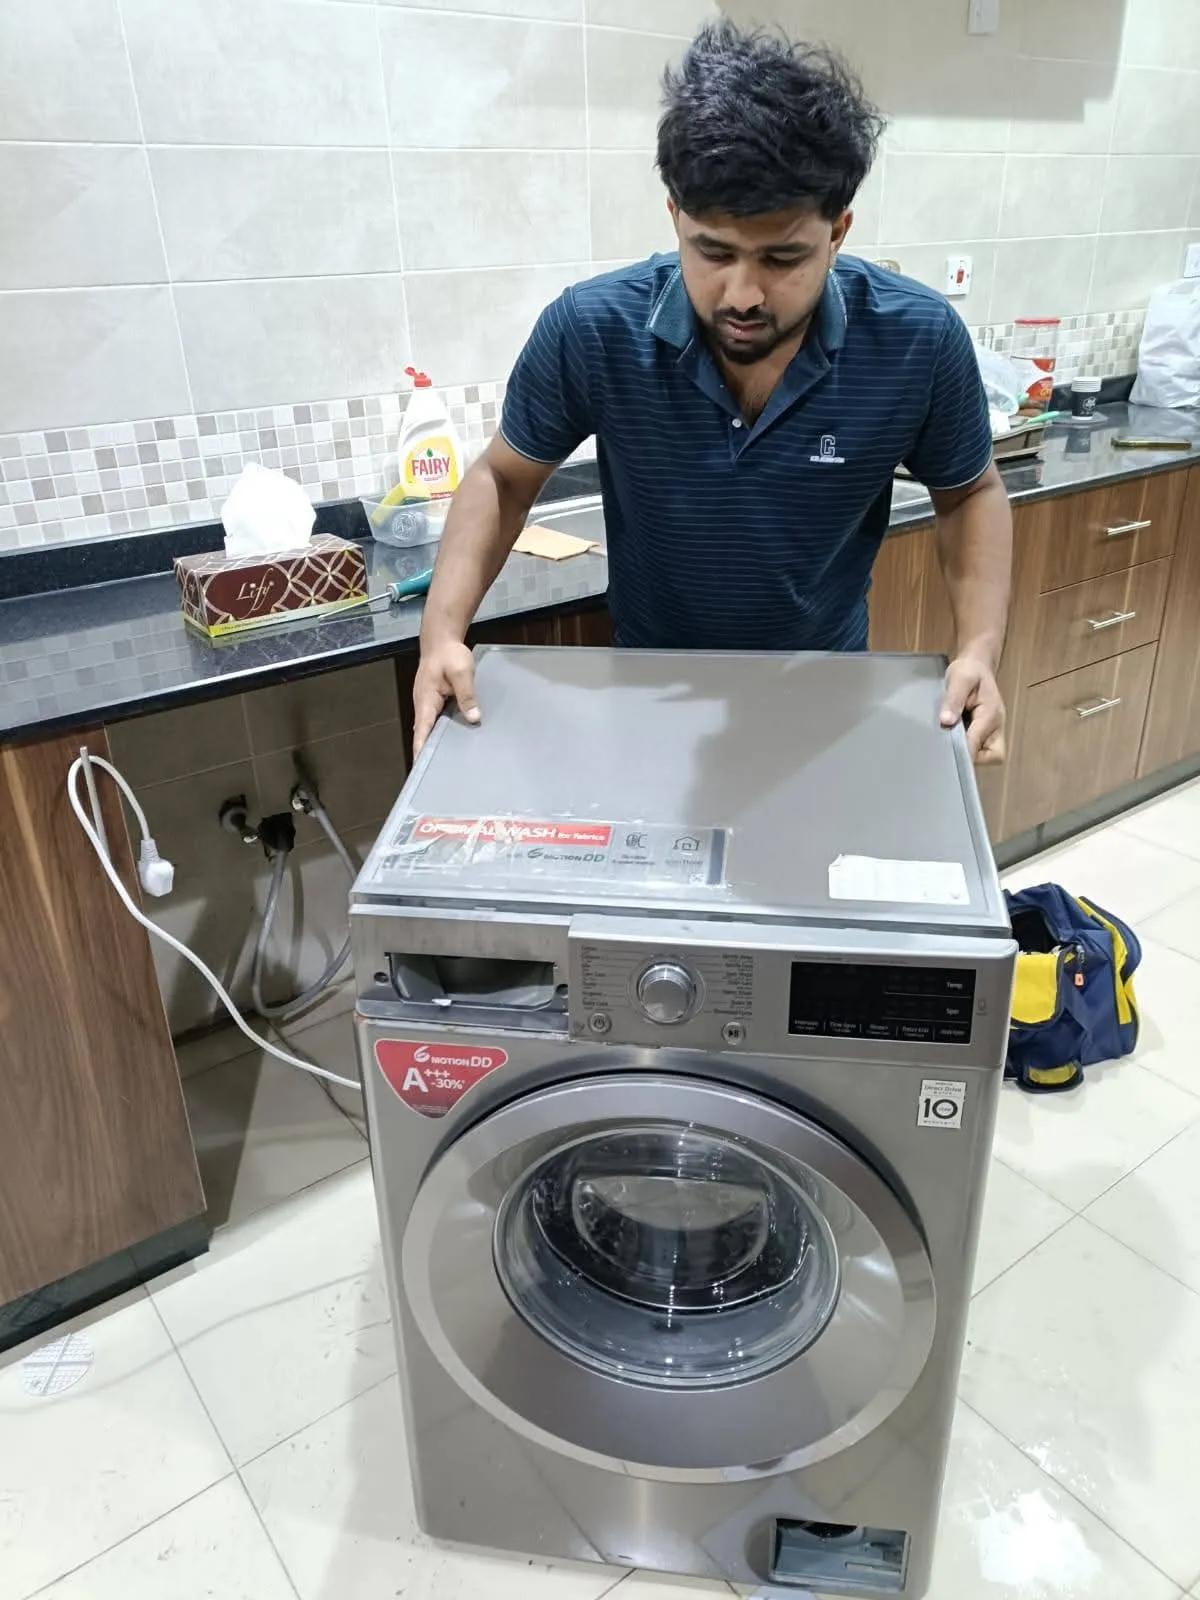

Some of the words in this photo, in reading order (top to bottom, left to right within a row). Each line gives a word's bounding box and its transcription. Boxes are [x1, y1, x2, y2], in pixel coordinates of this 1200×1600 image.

[411, 456, 450, 477] FAIRY
[506, 826, 557, 839] WASH
[583, 853, 605, 863] DD
[431, 1057, 470, 1067] MOTION
[470, 1055, 493, 1068] DD
[923, 1097, 959, 1120] 10
